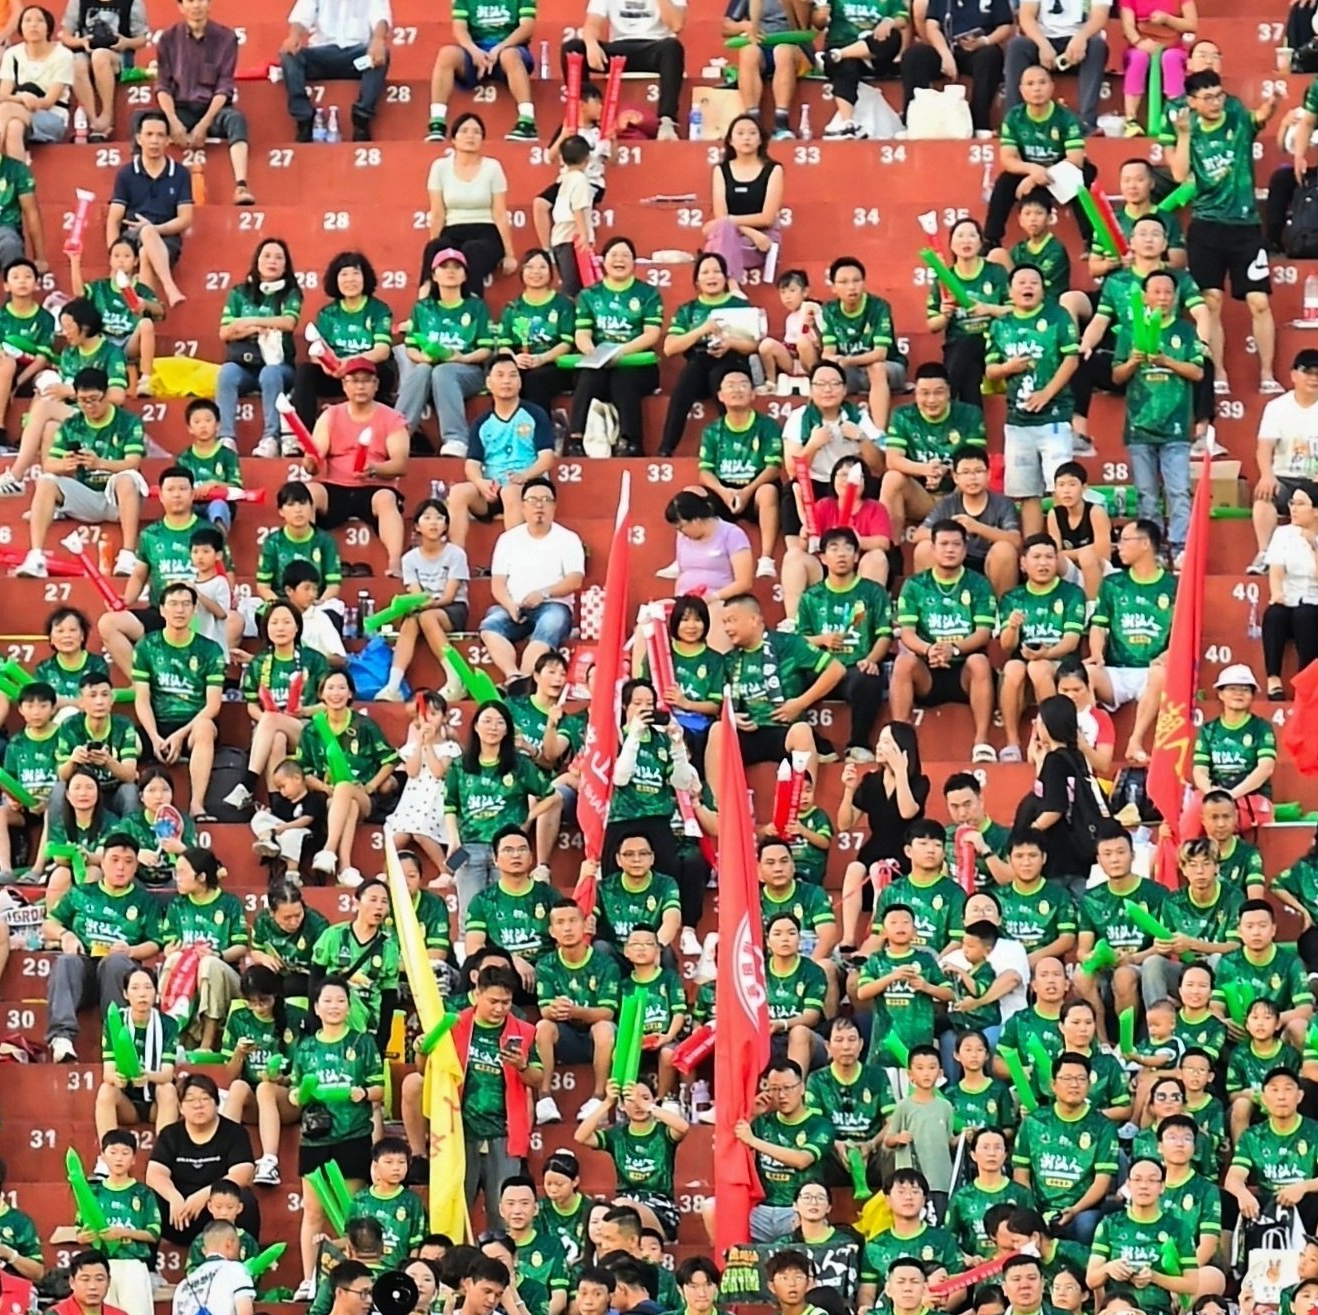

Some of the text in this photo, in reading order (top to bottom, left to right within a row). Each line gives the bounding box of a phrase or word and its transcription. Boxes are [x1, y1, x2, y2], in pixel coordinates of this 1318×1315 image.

[391, 26, 418, 47] 27
[1257, 22, 1285, 43] 37
[386, 85, 411, 103] 28
[354, 147, 383, 169] 28
[793, 145, 821, 166] 33
[238, 211, 265, 232] 27
[323, 211, 352, 232] 28
[852, 207, 881, 228] 34
[380, 270, 408, 290] 29
[1219, 400, 1245, 419] 39
[1204, 644, 1232, 664] 40
[6, 1009, 35, 1030] 30
[29, 1129, 56, 1149] 31
